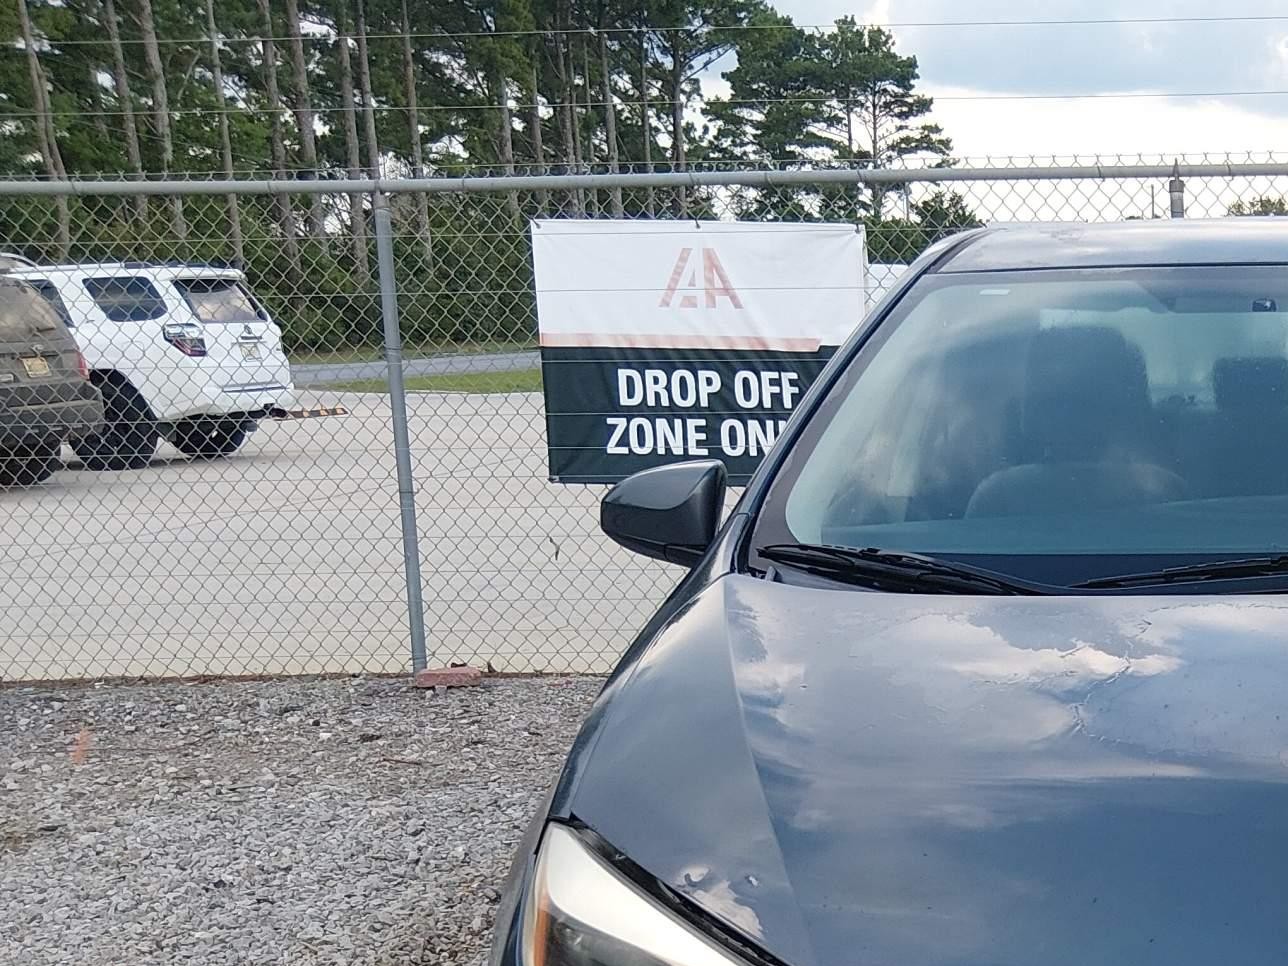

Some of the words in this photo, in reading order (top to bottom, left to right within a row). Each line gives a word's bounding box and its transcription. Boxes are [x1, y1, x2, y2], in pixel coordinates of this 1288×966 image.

[617, 368, 722, 408] DROP
[734, 371, 800, 409] OFF
[605, 418, 709, 456] ZONE
